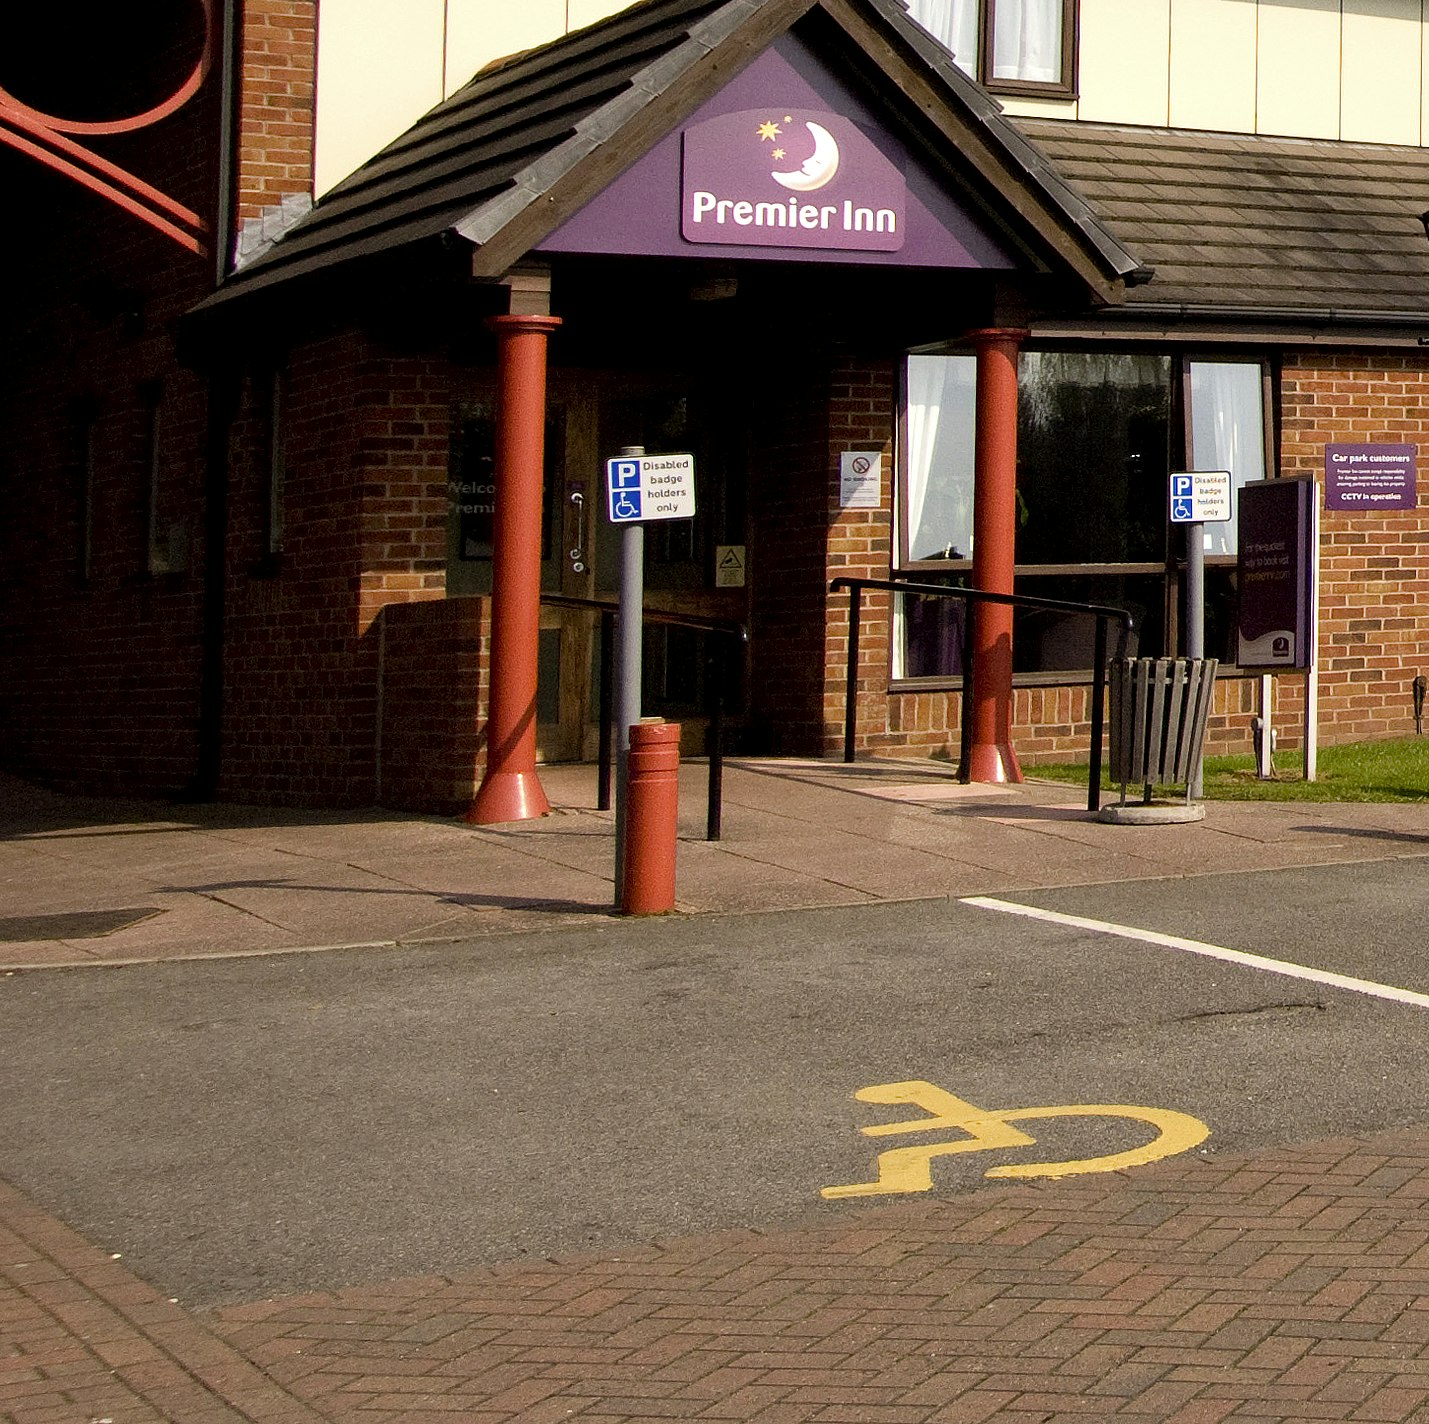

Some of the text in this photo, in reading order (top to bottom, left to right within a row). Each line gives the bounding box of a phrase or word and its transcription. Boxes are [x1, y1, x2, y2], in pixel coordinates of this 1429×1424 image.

[693, 191, 897, 233] Premier Inn
[1332, 453, 1410, 464] Car park customers
[643, 460, 689, 470] Disabled
[650, 475, 683, 484] badge
[448, 481, 496, 494] Welco
[647, 489, 687, 498] holders
[1370, 493, 1402, 501] operation
[656, 503, 679, 512] only
[1203, 508, 1219, 516] only
